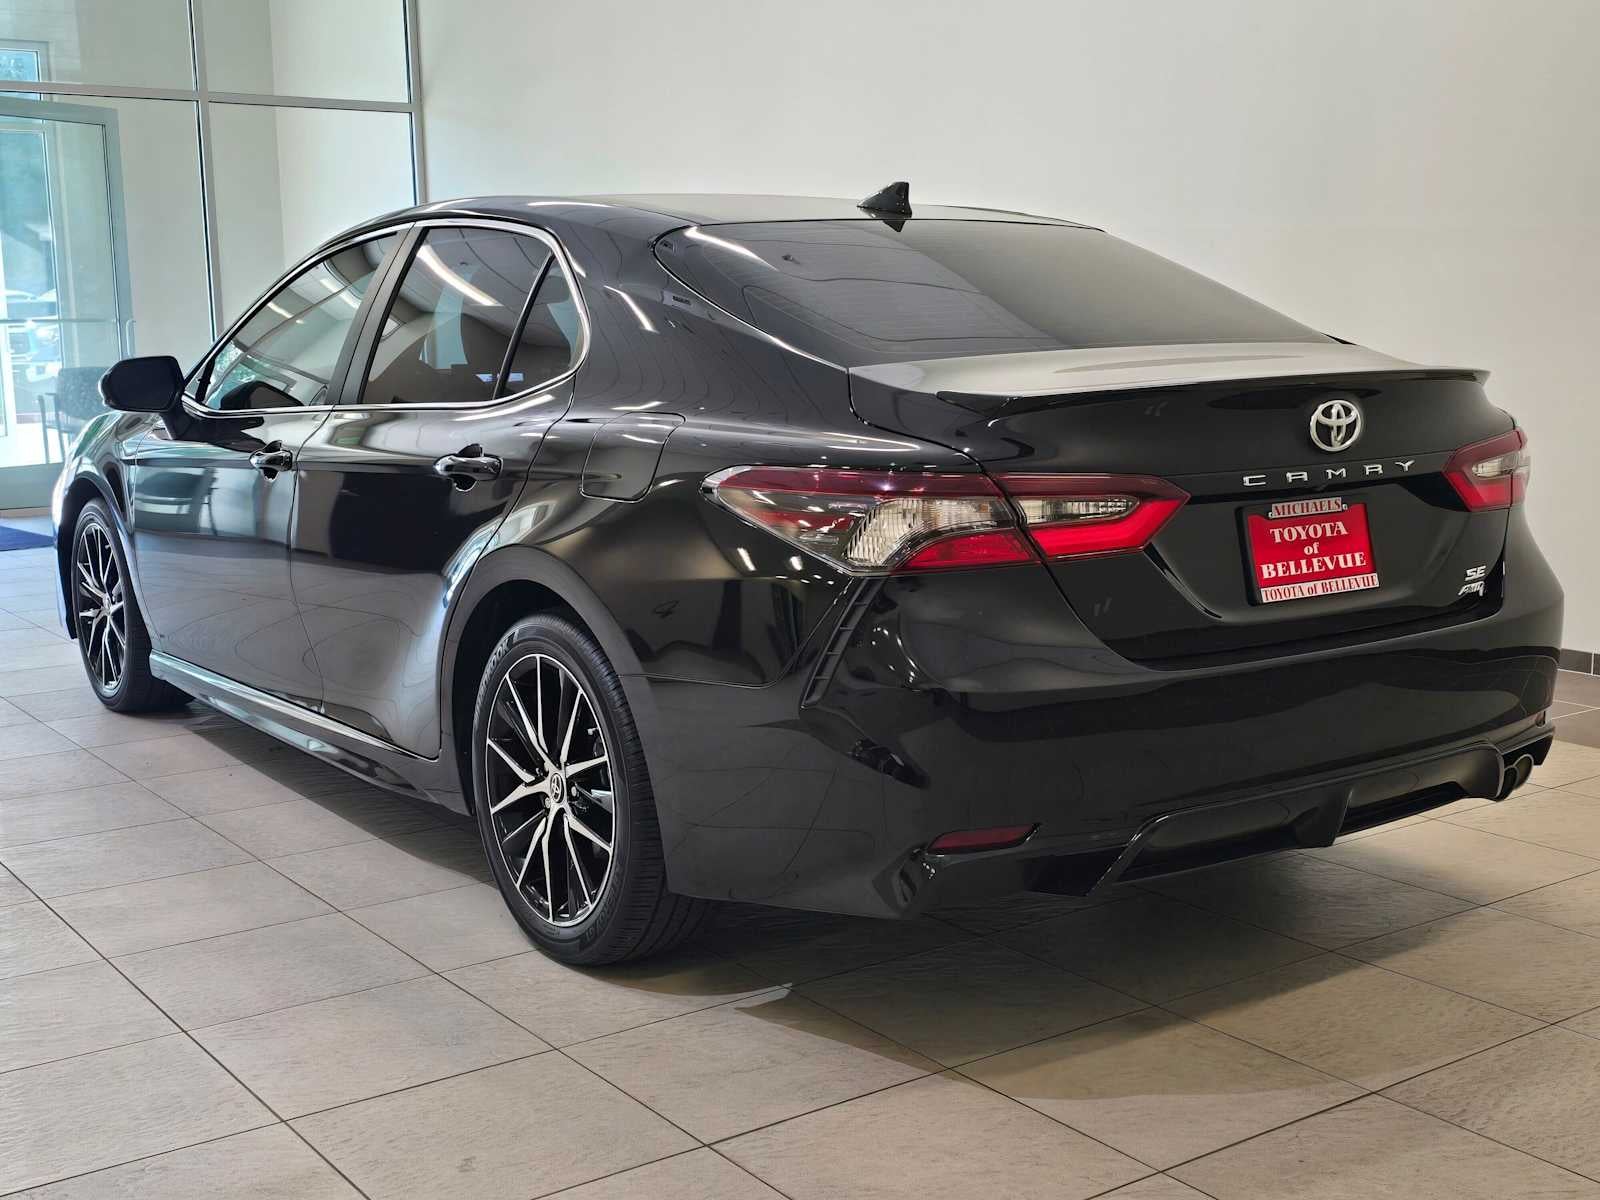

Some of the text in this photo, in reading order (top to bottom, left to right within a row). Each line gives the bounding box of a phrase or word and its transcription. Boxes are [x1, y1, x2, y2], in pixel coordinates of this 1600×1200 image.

[1242, 459, 1415, 486] CAMRY
[1273, 498, 1341, 516] MICHAELS
[1270, 521, 1348, 543] TOYOTA
[1303, 542, 1319, 555] of
[1260, 552, 1366, 579] BELLEVUE
[1465, 565, 1486, 581] SE
[1263, 574, 1378, 601] TOYOTA of BELLEVUE
